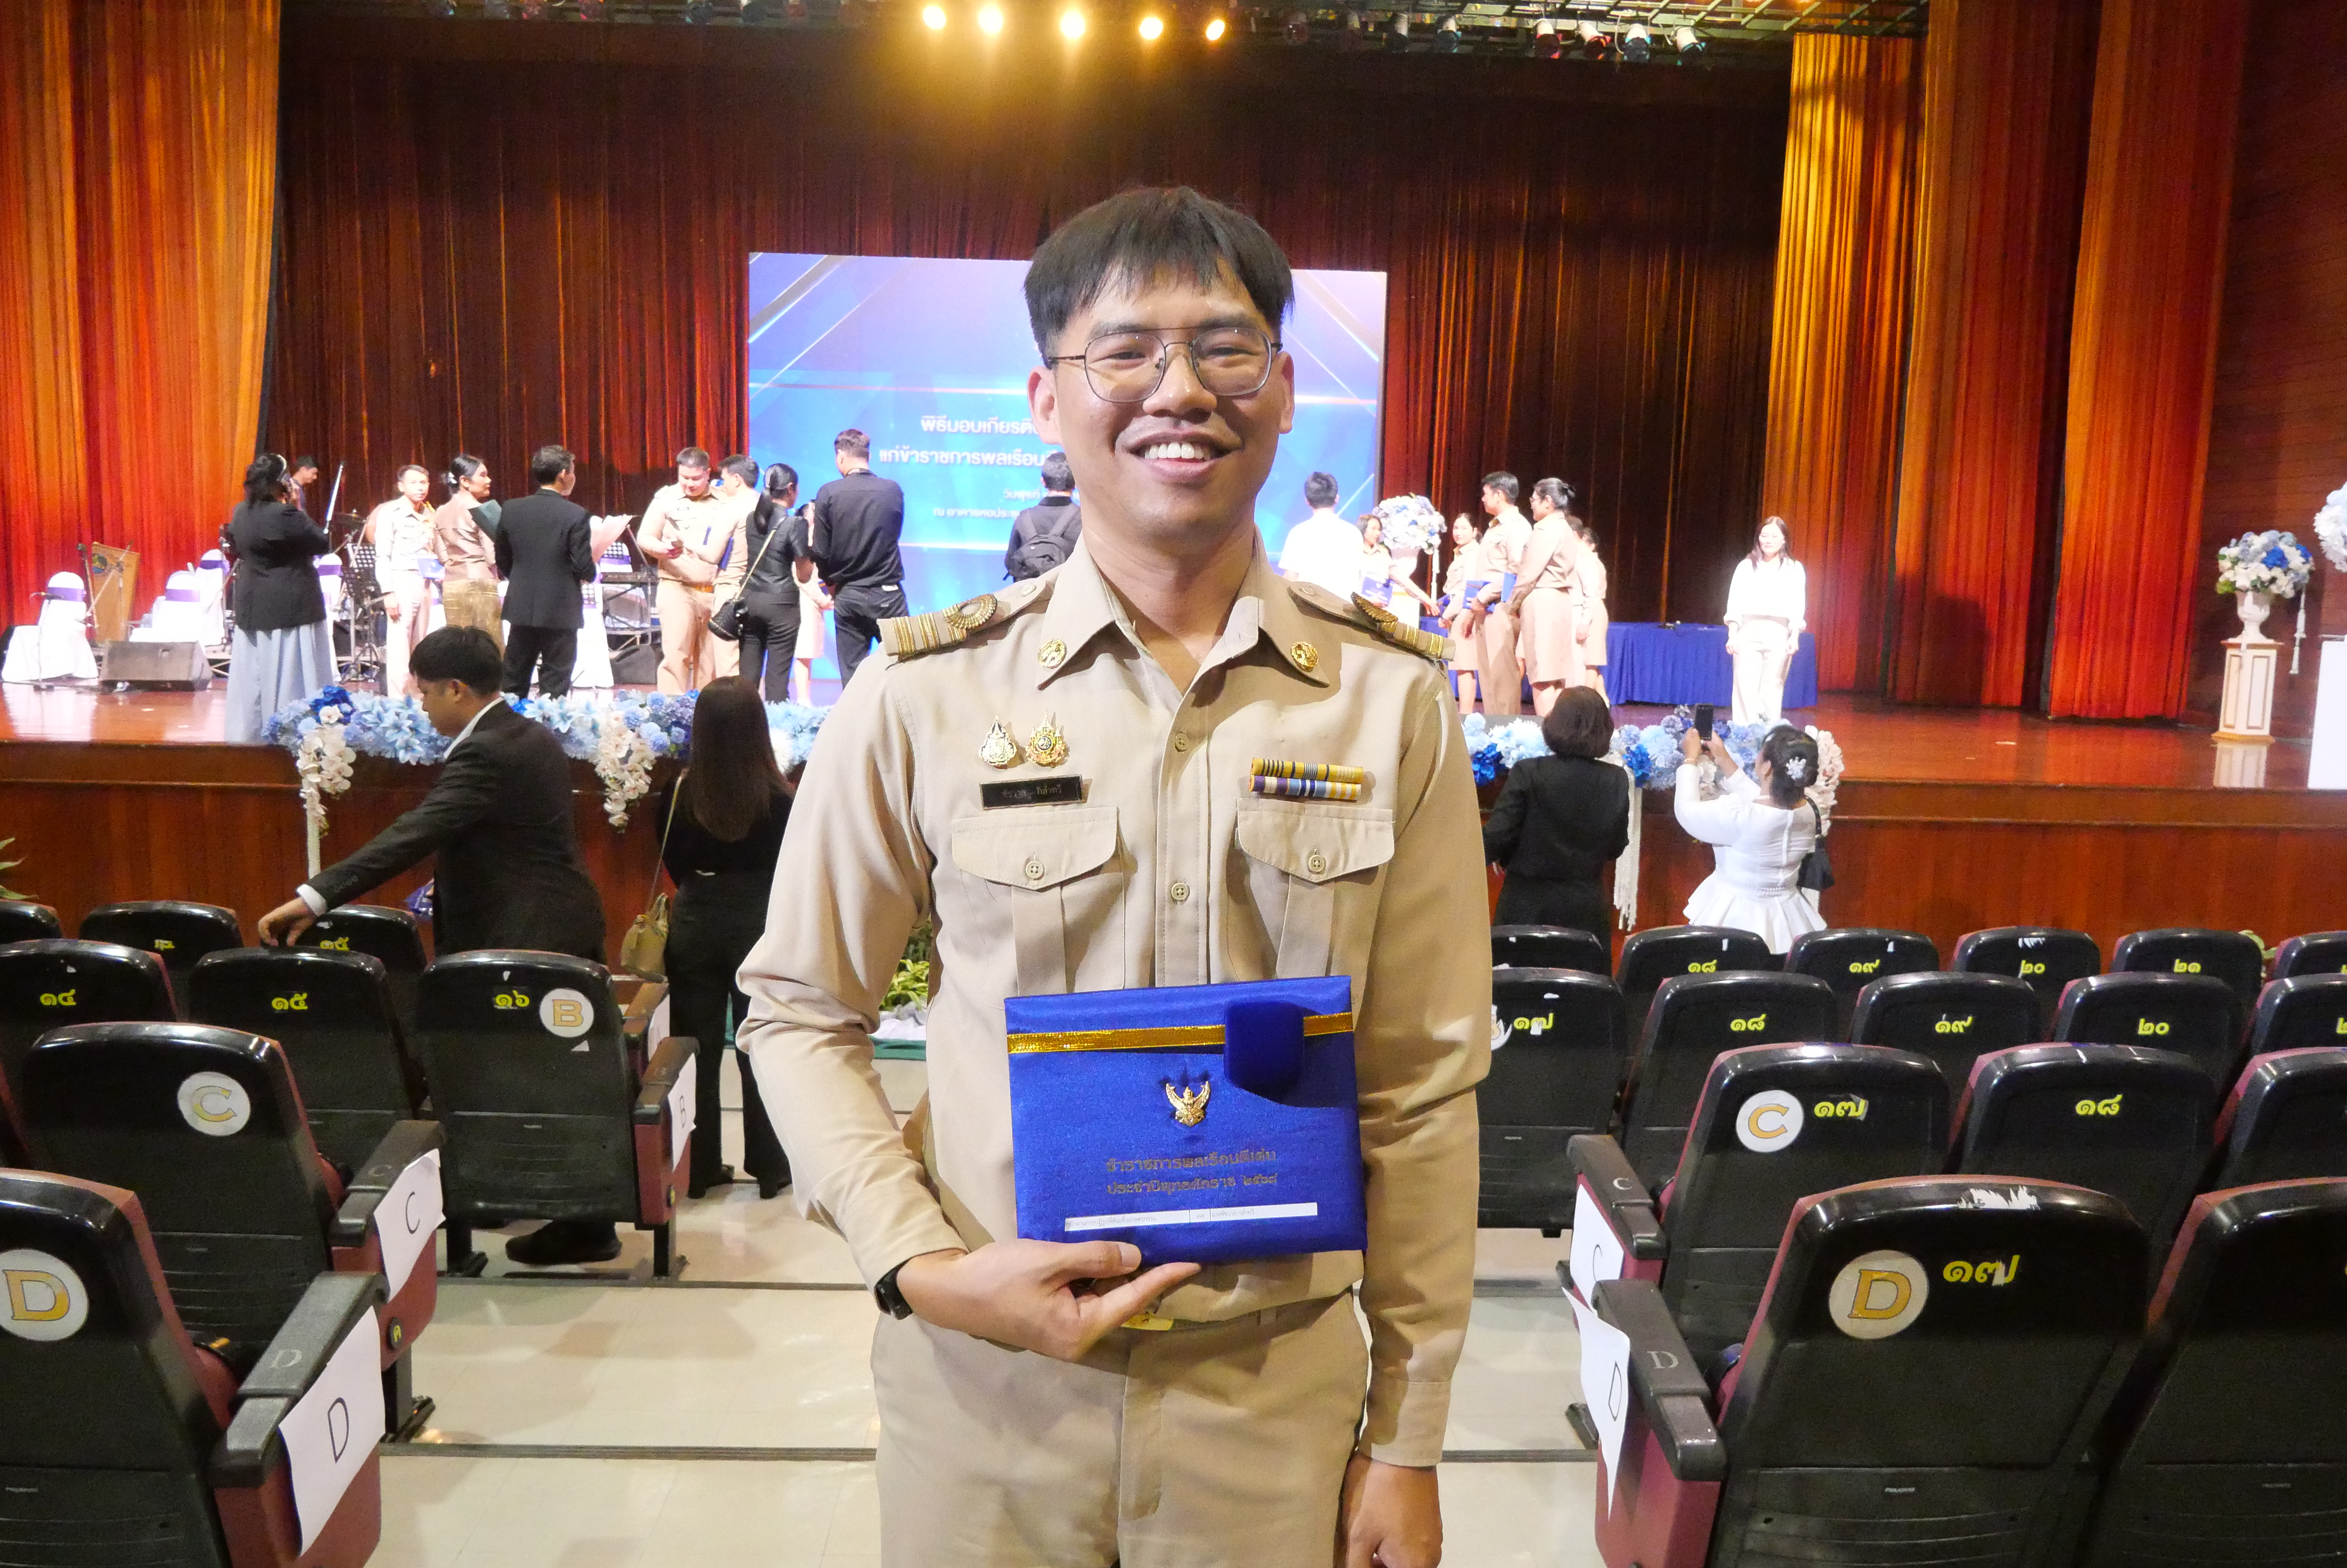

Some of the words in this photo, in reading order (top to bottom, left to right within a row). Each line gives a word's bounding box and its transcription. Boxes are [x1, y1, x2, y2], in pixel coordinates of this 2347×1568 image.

[879, 445, 1050, 467] แก่ข้าราชการพลเรือน
[947, 506, 1020, 519] อาคารหอประช
[1688, 959, 1718, 973] ๑๘
[1849, 959, 1880, 974] ๑๙
[2021, 959, 2045, 974] ๒๐
[2174, 959, 2202, 974] ๒๑
[40, 989, 77, 1007] ๑๔
[272, 993, 309, 1010] ๑๕
[494, 989, 530, 1008] ๑๖
[552, 998, 583, 1027] B
[1513, 1013, 1554, 1029] ๑๗
[1730, 1014, 1767, 1031] ๑๘
[1935, 1016, 1973, 1034] ๑๙
[2138, 1018, 2170, 1036] ๒๐
[192, 1085, 238, 1122] C
[1813, 1098, 1868, 1118] ๑๗
[2076, 1094, 2123, 1116] ๑๘
[1747, 1103, 1789, 1139] C
[1612, 1177, 1633, 1191] C
[405, 1191, 420, 1235] C
[1065, 1215, 1157, 1228] ำนักงานการปฏิรูปที่ดินเพื่อเกษตรกรรม
[1943, 1254, 2020, 1286] ๑๗
[3, 1269, 70, 1321] D
[1847, 1268, 1913, 1320] D
[269, 1348, 302, 1368] D
[1647, 1351, 1679, 1369] D
[1608, 1360, 1622, 1422] D
[327, 1396, 350, 1464] D
